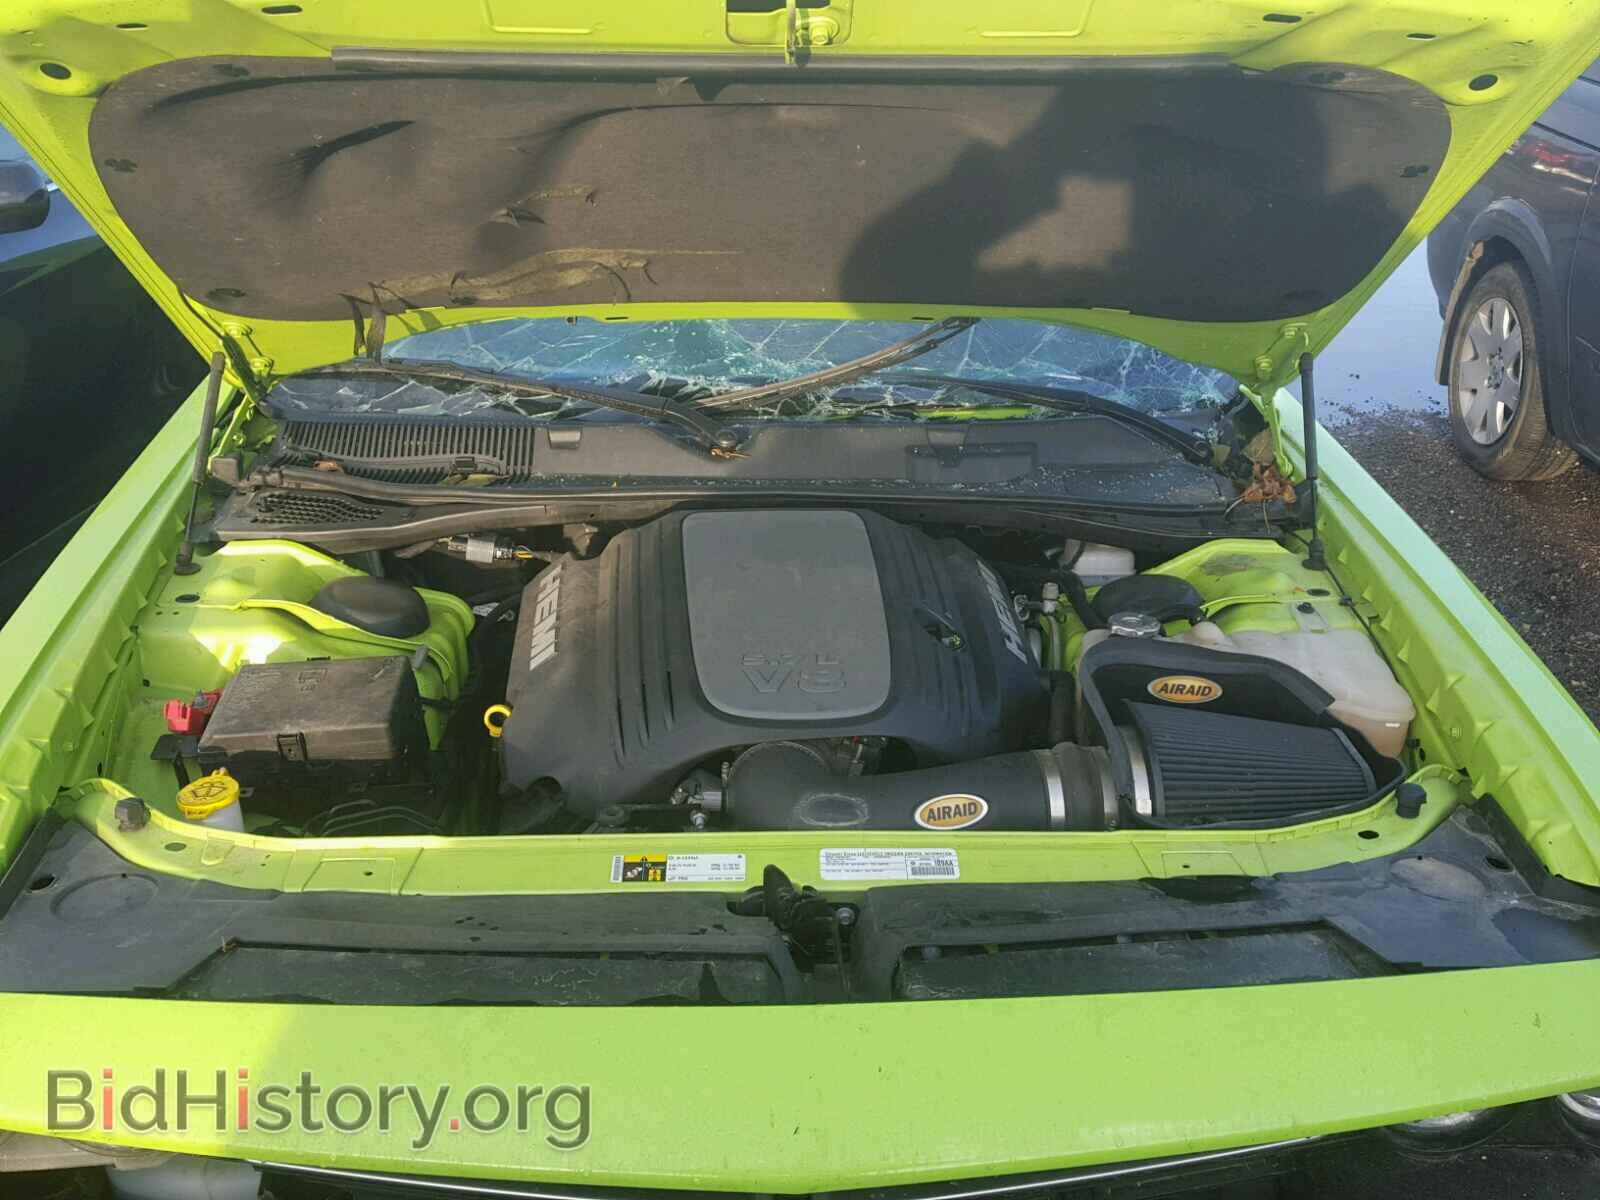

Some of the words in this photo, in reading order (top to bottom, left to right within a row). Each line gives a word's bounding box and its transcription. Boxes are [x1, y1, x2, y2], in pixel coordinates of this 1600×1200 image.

[529, 564, 561, 671] HEMI
[1159, 682, 1212, 697] AIRAID
[927, 802, 977, 824] AIRAID
